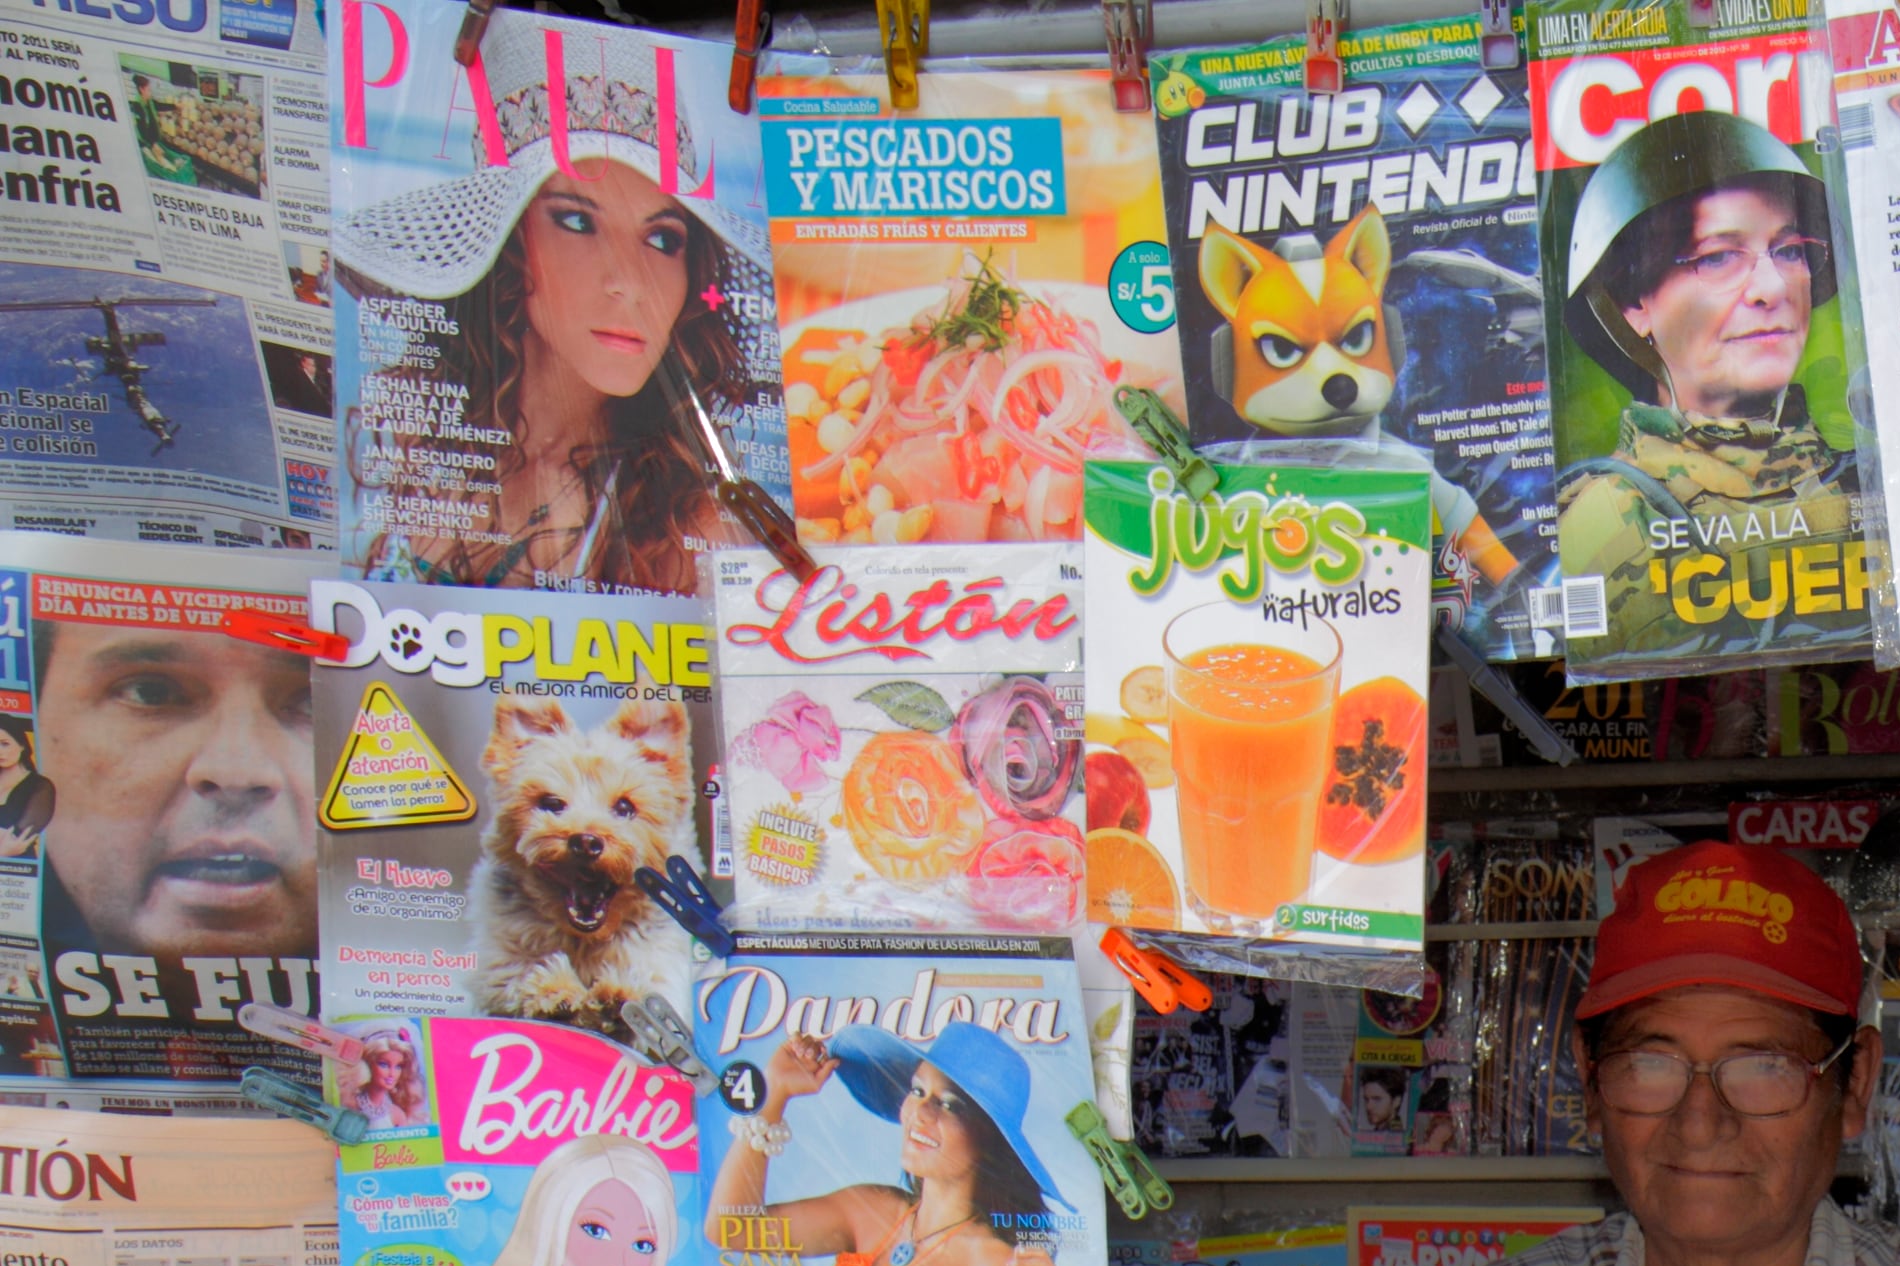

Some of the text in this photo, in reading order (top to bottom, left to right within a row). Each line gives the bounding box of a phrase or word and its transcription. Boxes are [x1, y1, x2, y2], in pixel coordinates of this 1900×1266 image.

[784, 101, 877, 114] Cocina Saludable
[786, 125, 1014, 167] PESCADOS
[1186, 87, 1383, 168] CLUB
[791, 170, 1054, 211] Y MARISCOS
[153, 193, 265, 228] DESEMPLEO BAJA
[189, 218, 242, 240] EN LIMA
[359, 297, 446, 320] ASPERGER
[359, 311, 459, 336] EN ADULTOS
[1434, 426, 1465, 443] Harvest
[1501, 419, 1518, 435] The
[1518, 418, 1538, 433] Tale
[1539, 415, 1549, 430] of
[363, 508, 472, 529] SHEVCHENKO
[1130, 468, 1366, 599] jugos
[1649, 508, 1811, 551] SE VA A LA
[727, 564, 1078, 664] Listón
[1262, 583, 1402, 630] naturales
[490, 682, 676, 702] EL MEJOR AMIGO DEL
[357, 712, 411, 734] Alerta
[1736, 805, 1871, 845] CARAS
[1655, 878, 1794, 923] GOLAZO
[1302, 909, 1370, 931] surtidos
[701, 966, 1069, 1055] Pandora
[459, 1032, 699, 1155] Barbie
[719, 1215, 804, 1252] PIEL
